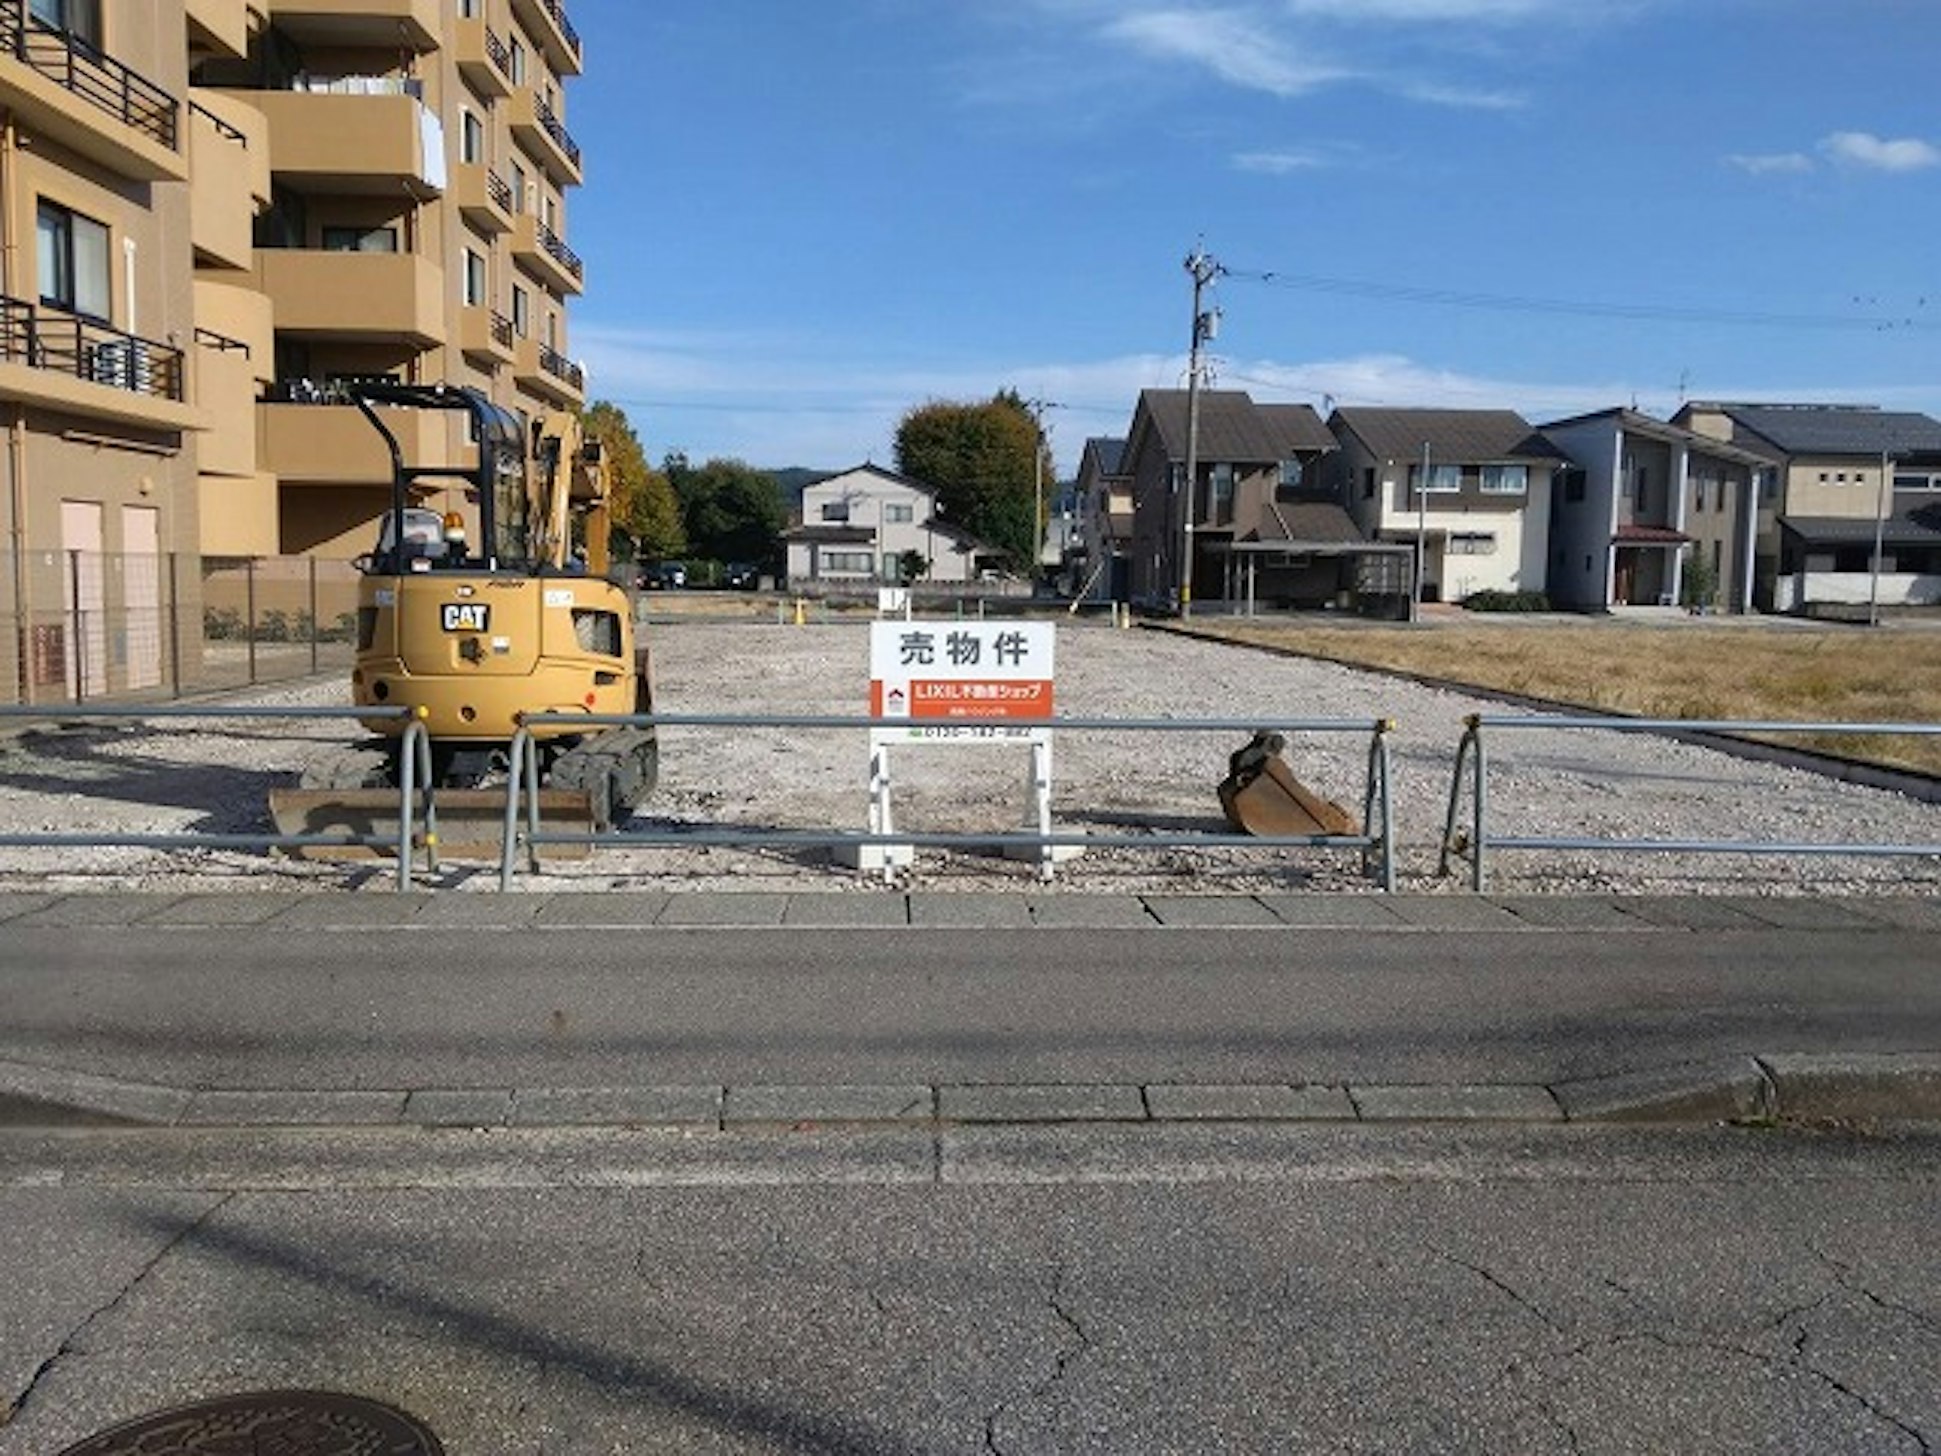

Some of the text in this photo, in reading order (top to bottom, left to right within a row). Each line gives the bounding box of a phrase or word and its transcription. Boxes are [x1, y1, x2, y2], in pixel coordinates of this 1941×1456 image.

[444, 604, 487, 630] CAT
[901, 631, 1029, 666] 売物件
